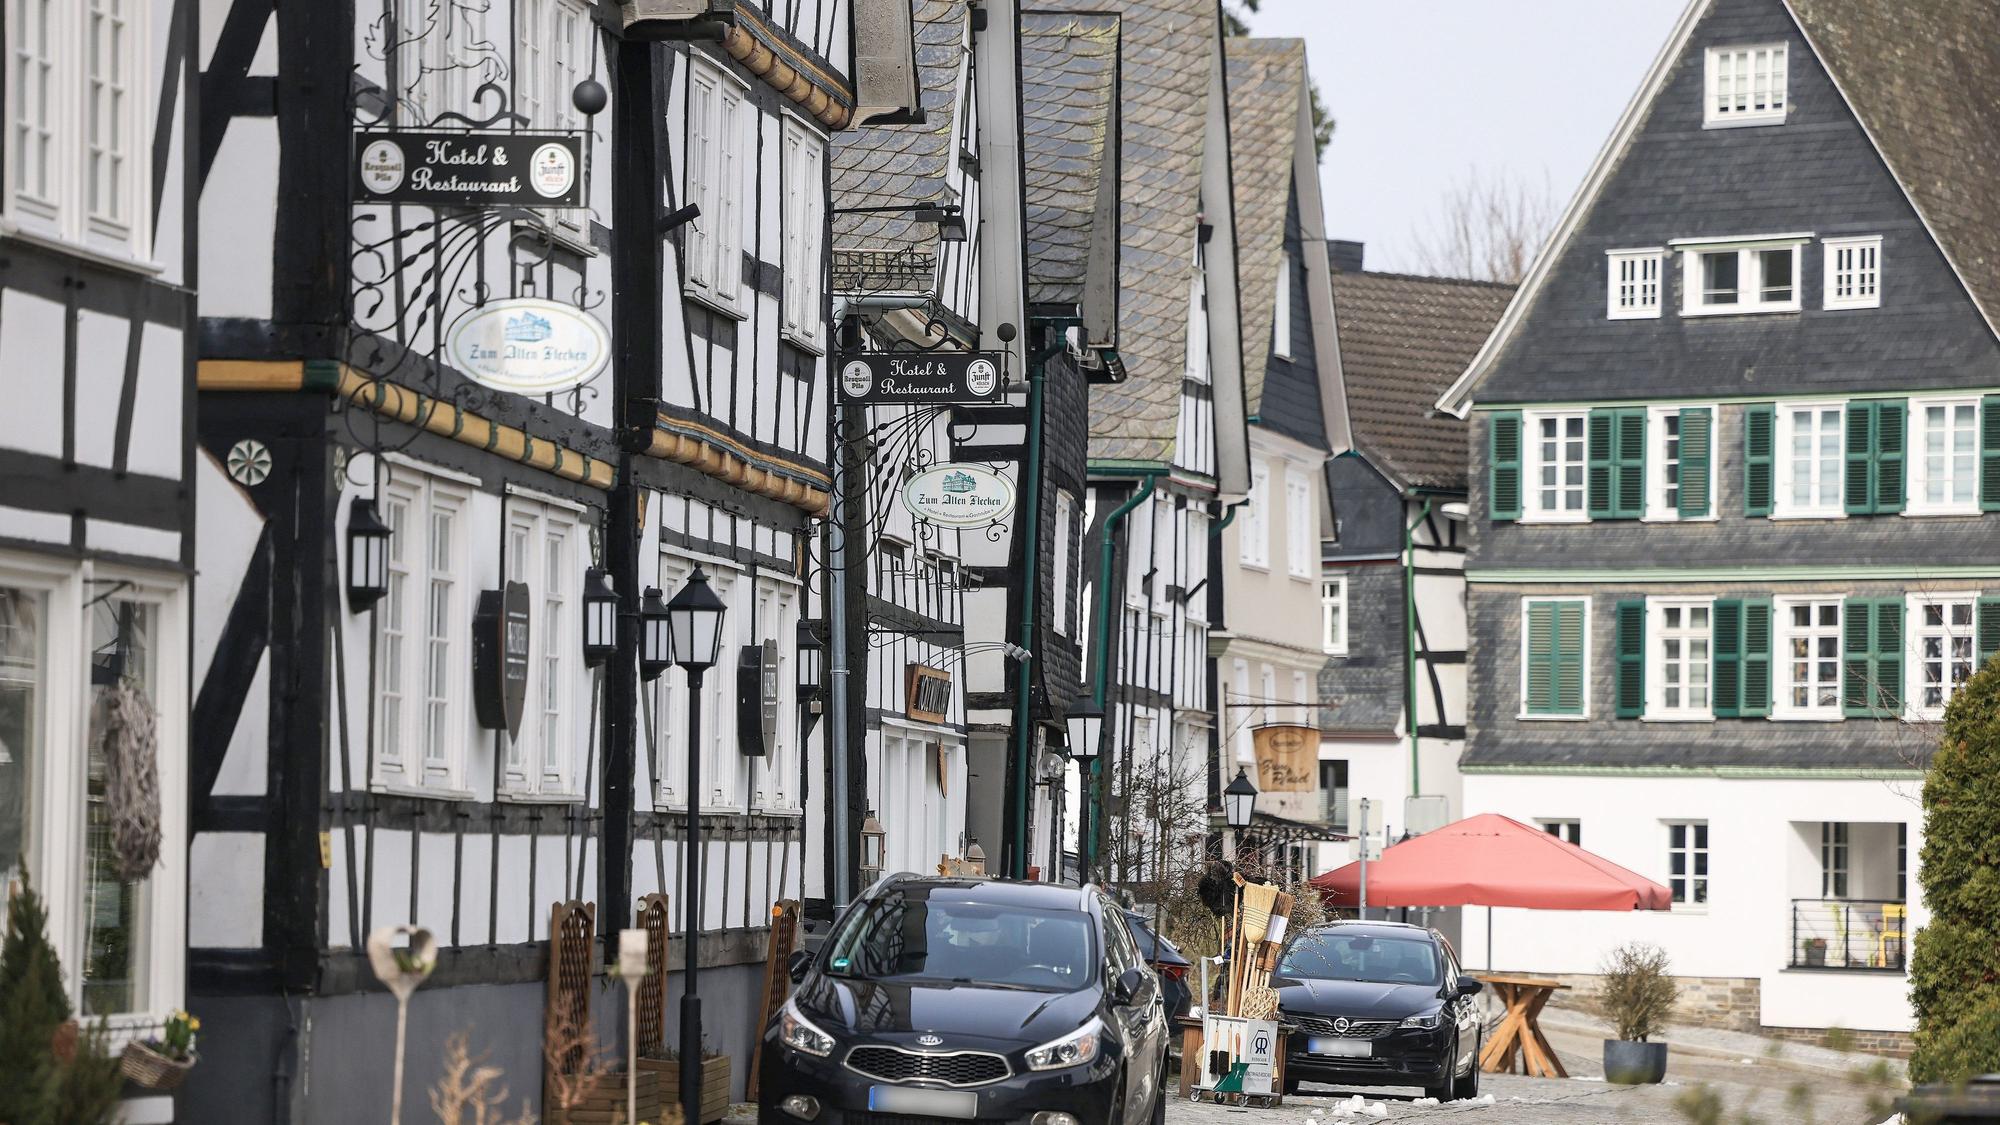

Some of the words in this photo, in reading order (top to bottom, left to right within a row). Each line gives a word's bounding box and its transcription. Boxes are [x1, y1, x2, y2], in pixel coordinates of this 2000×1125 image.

[426, 140, 488, 165] Hotel
[492, 146, 509, 166] &
[411, 167, 522, 192] Restaurant
[470, 344, 497, 359] Zum
[504, 345, 538, 360] Alten
[544, 346, 587, 361] Flecken
[890, 360, 933, 376] Hotel
[937, 362, 947, 376] &
[971, 371, 991, 382] Zunft
[880, 378, 956, 395] Restaurant
[918, 493, 938, 504] Zum
[942, 494, 966, 505] Alten
[970, 495, 1001, 506] Flecken
